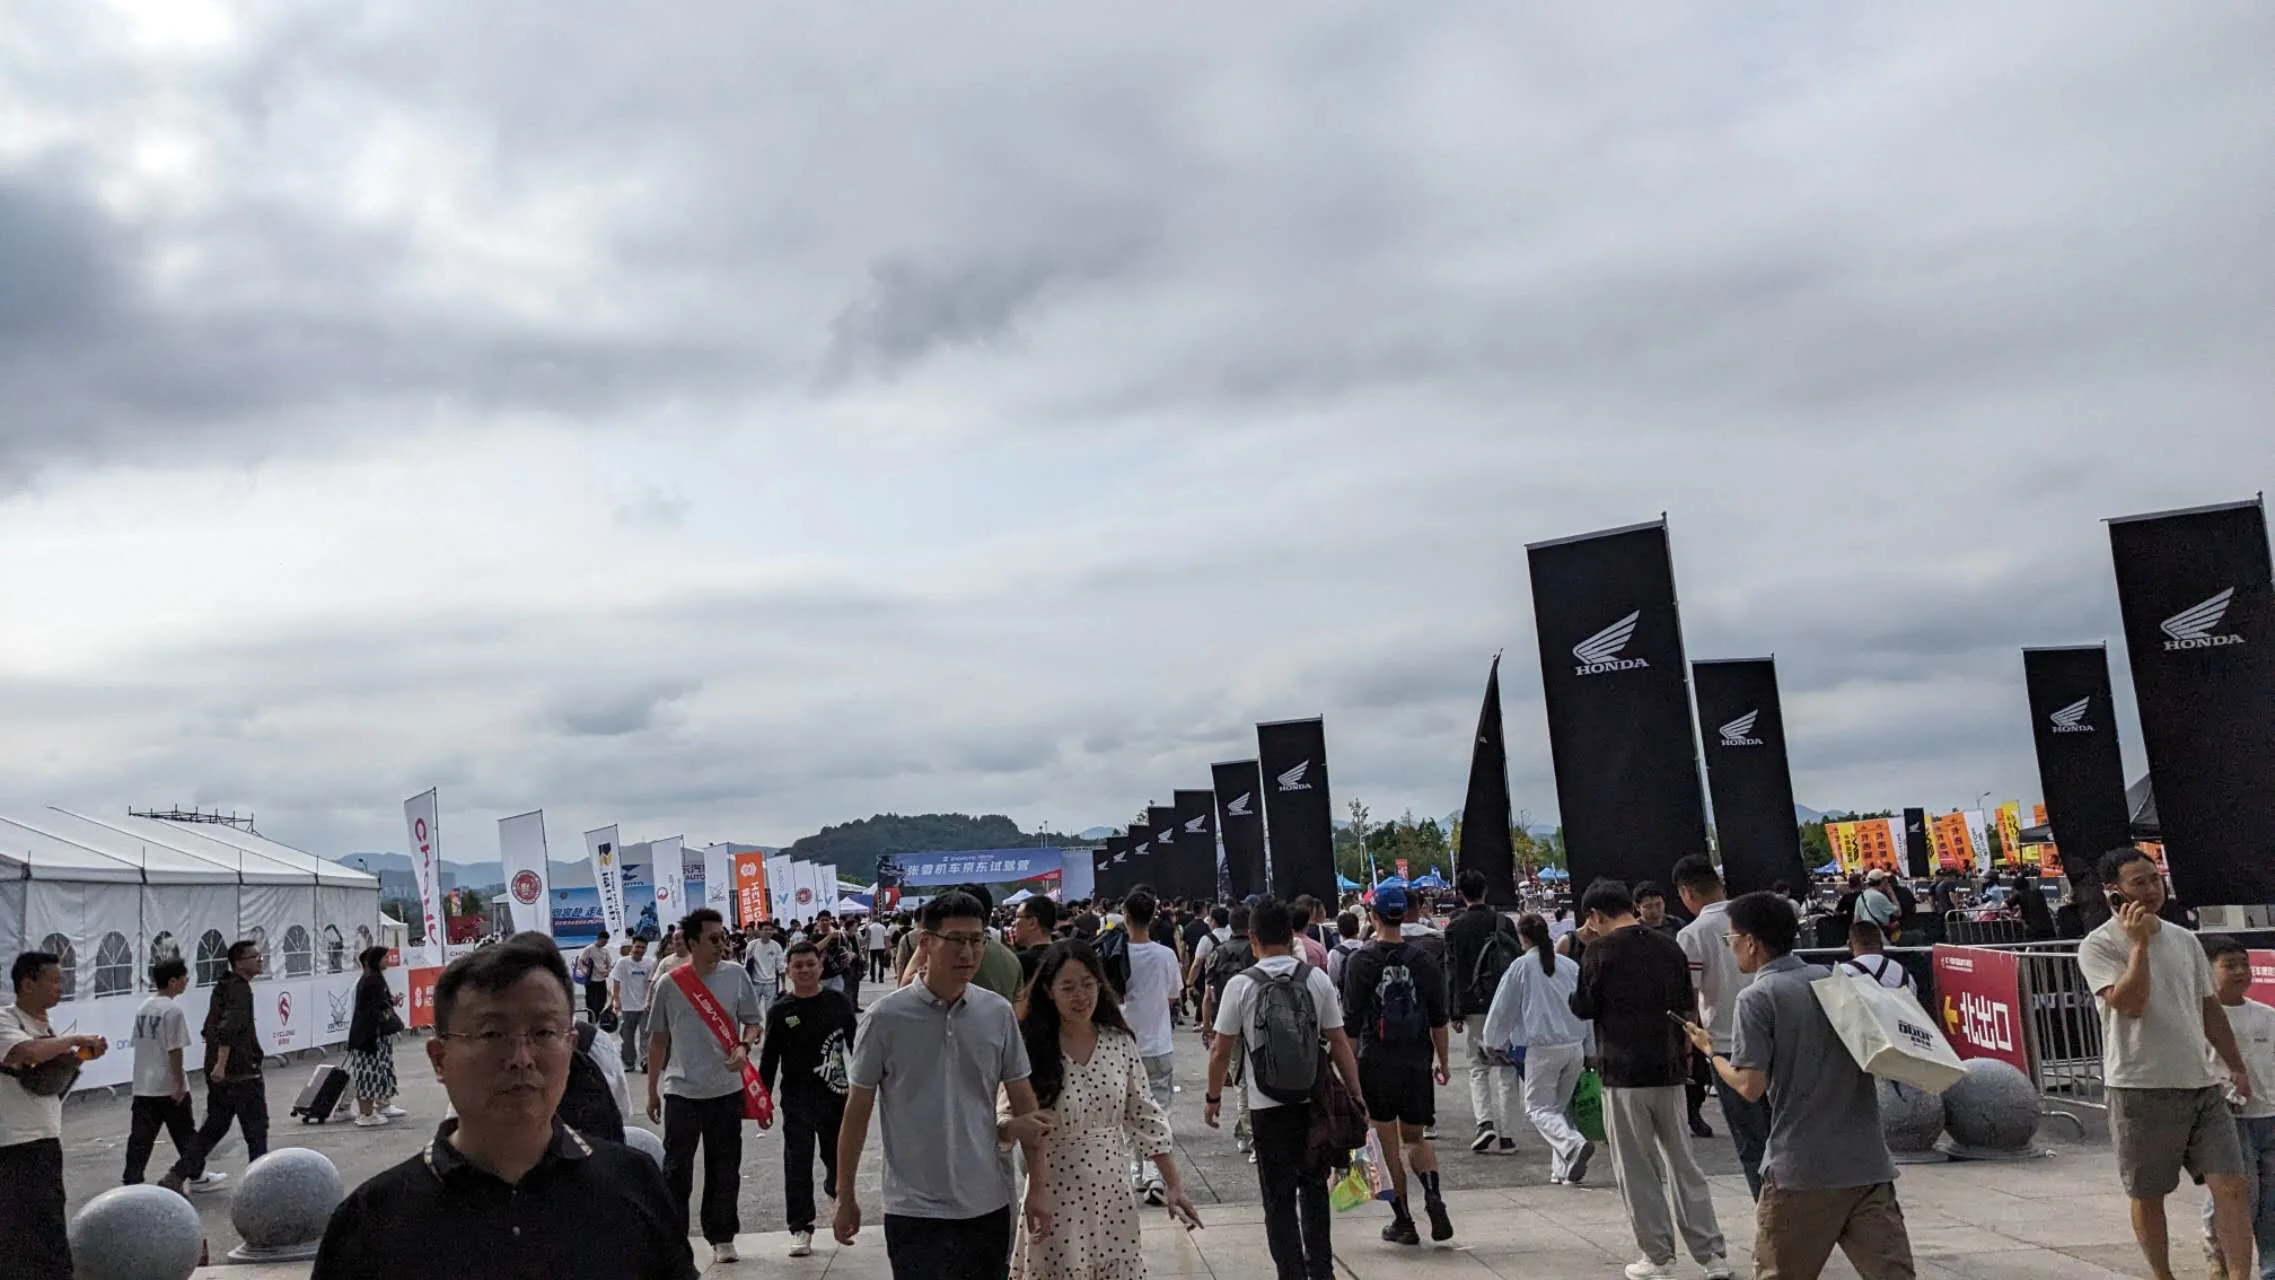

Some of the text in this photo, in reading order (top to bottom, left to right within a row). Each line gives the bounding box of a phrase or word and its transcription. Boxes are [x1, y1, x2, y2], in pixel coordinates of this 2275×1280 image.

[2162, 634, 2246, 651] HONDA
[1575, 658, 1650, 676] HONDA
[2052, 725, 2095, 733] HONDA
[1721, 738, 1764, 746] HONDA
[1279, 783, 1312, 791] HONDA
[1960, 991, 2013, 1052] 北出口
